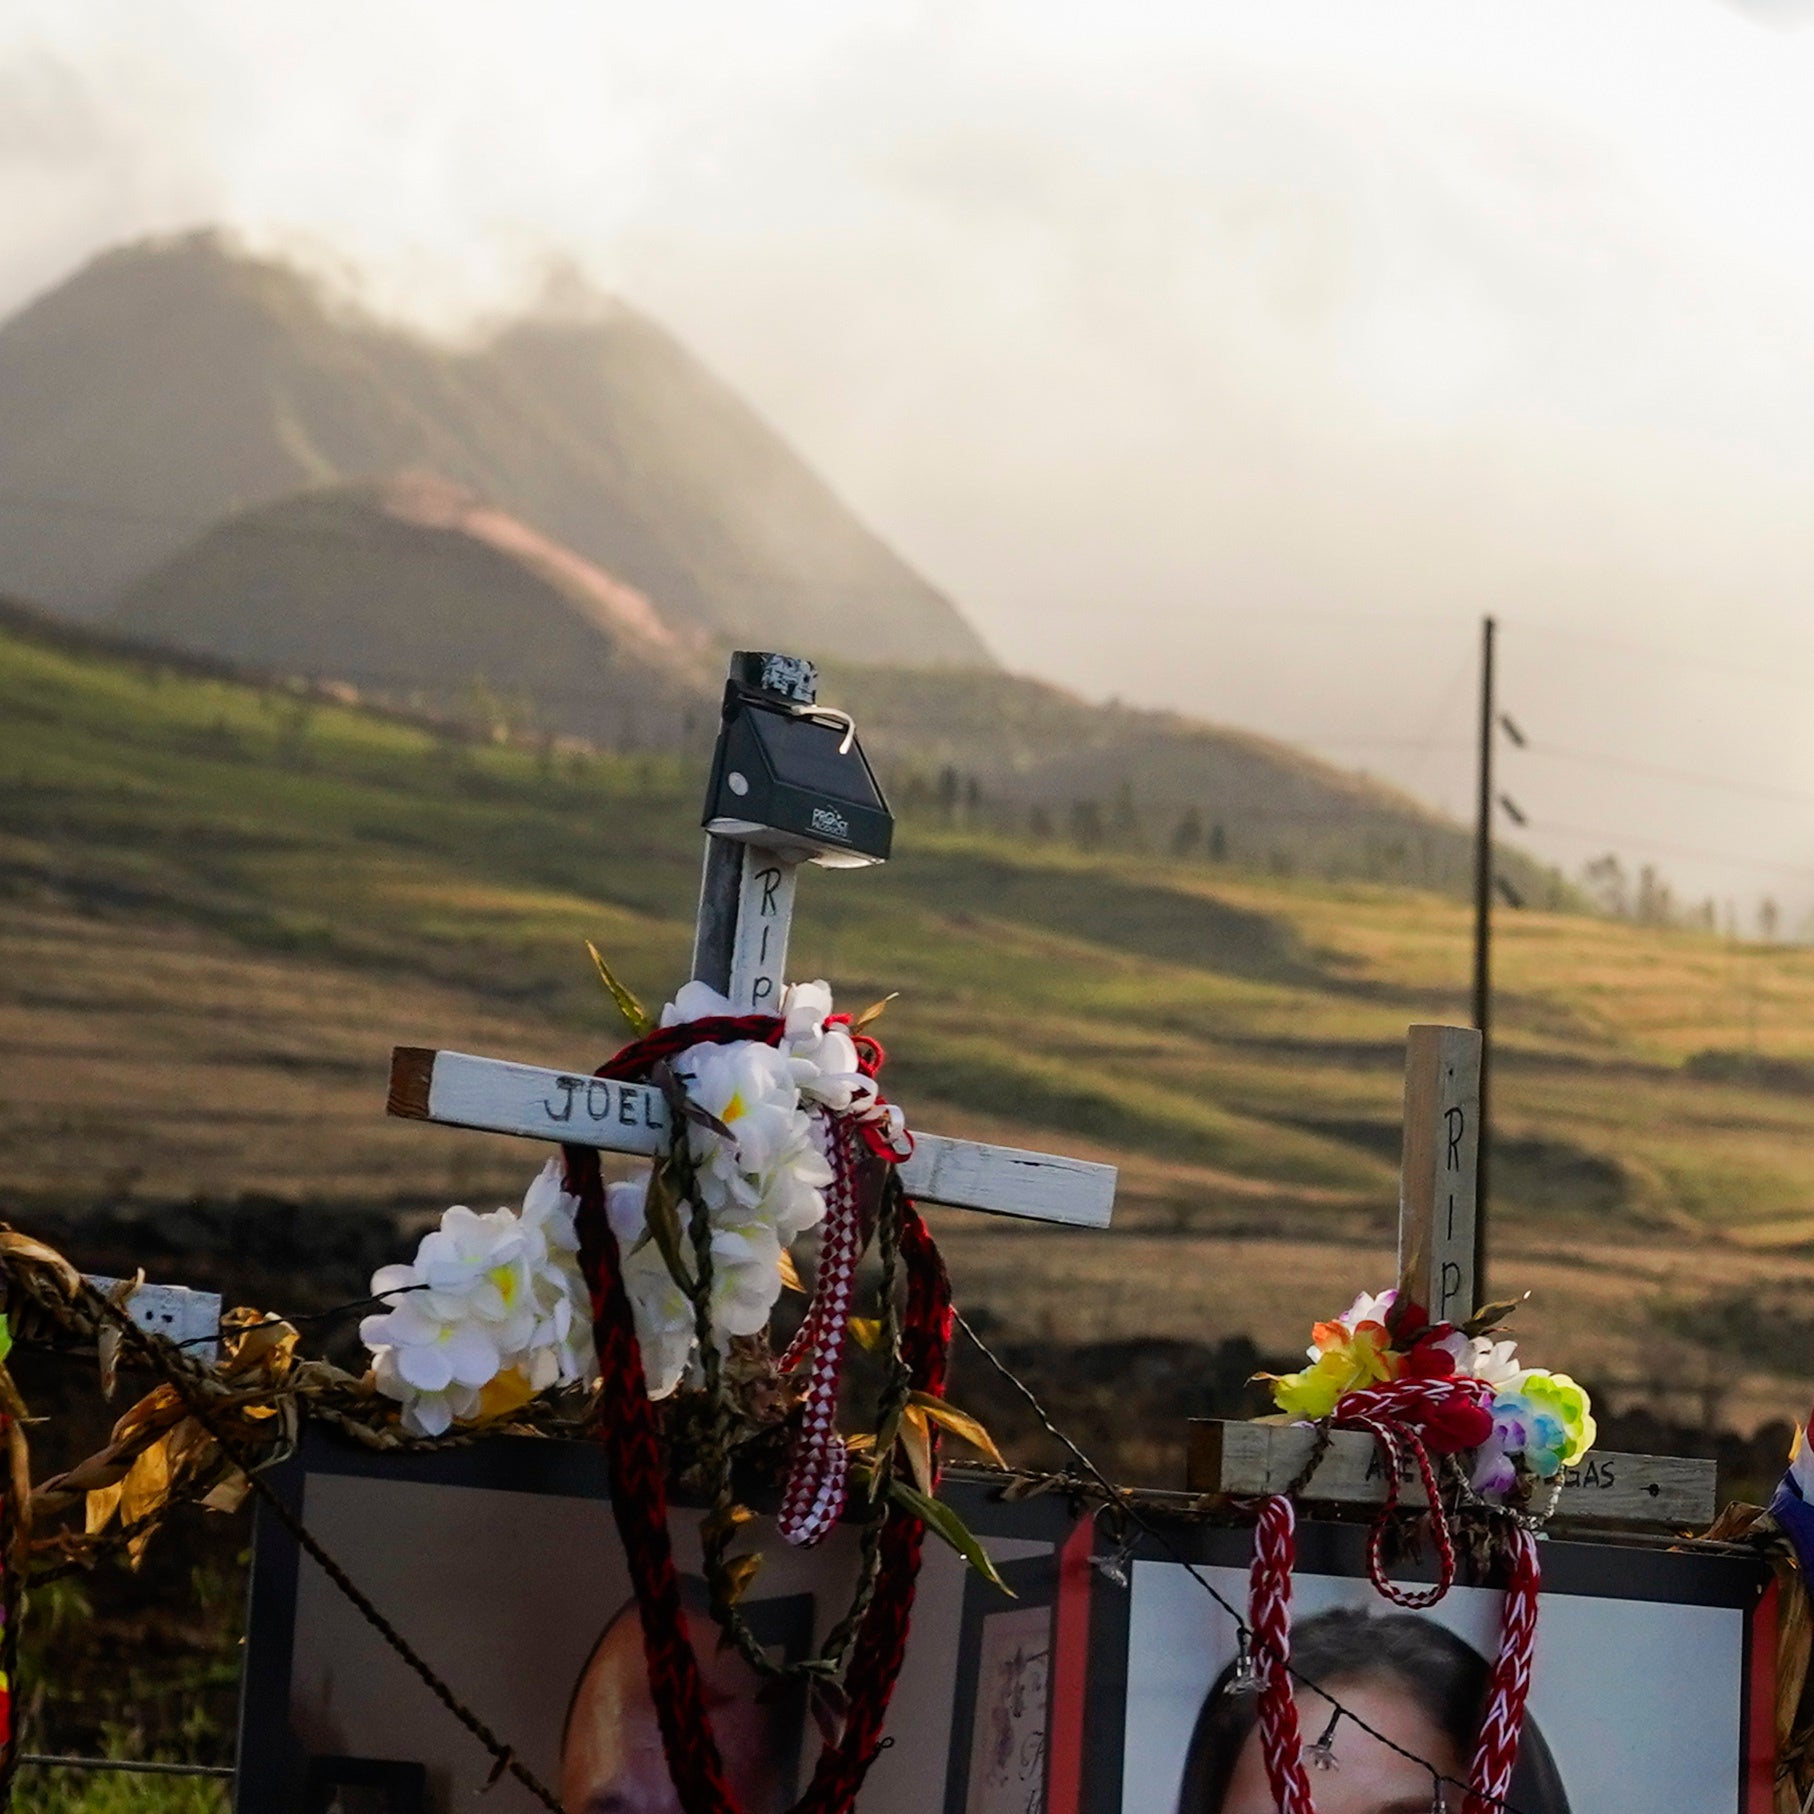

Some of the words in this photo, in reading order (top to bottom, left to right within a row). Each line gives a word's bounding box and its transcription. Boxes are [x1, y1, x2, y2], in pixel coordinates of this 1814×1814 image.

[755, 866, 782, 1007] RIP
[544, 1075, 665, 1130] JOEL
[1441, 1106, 1465, 1321] RIP
